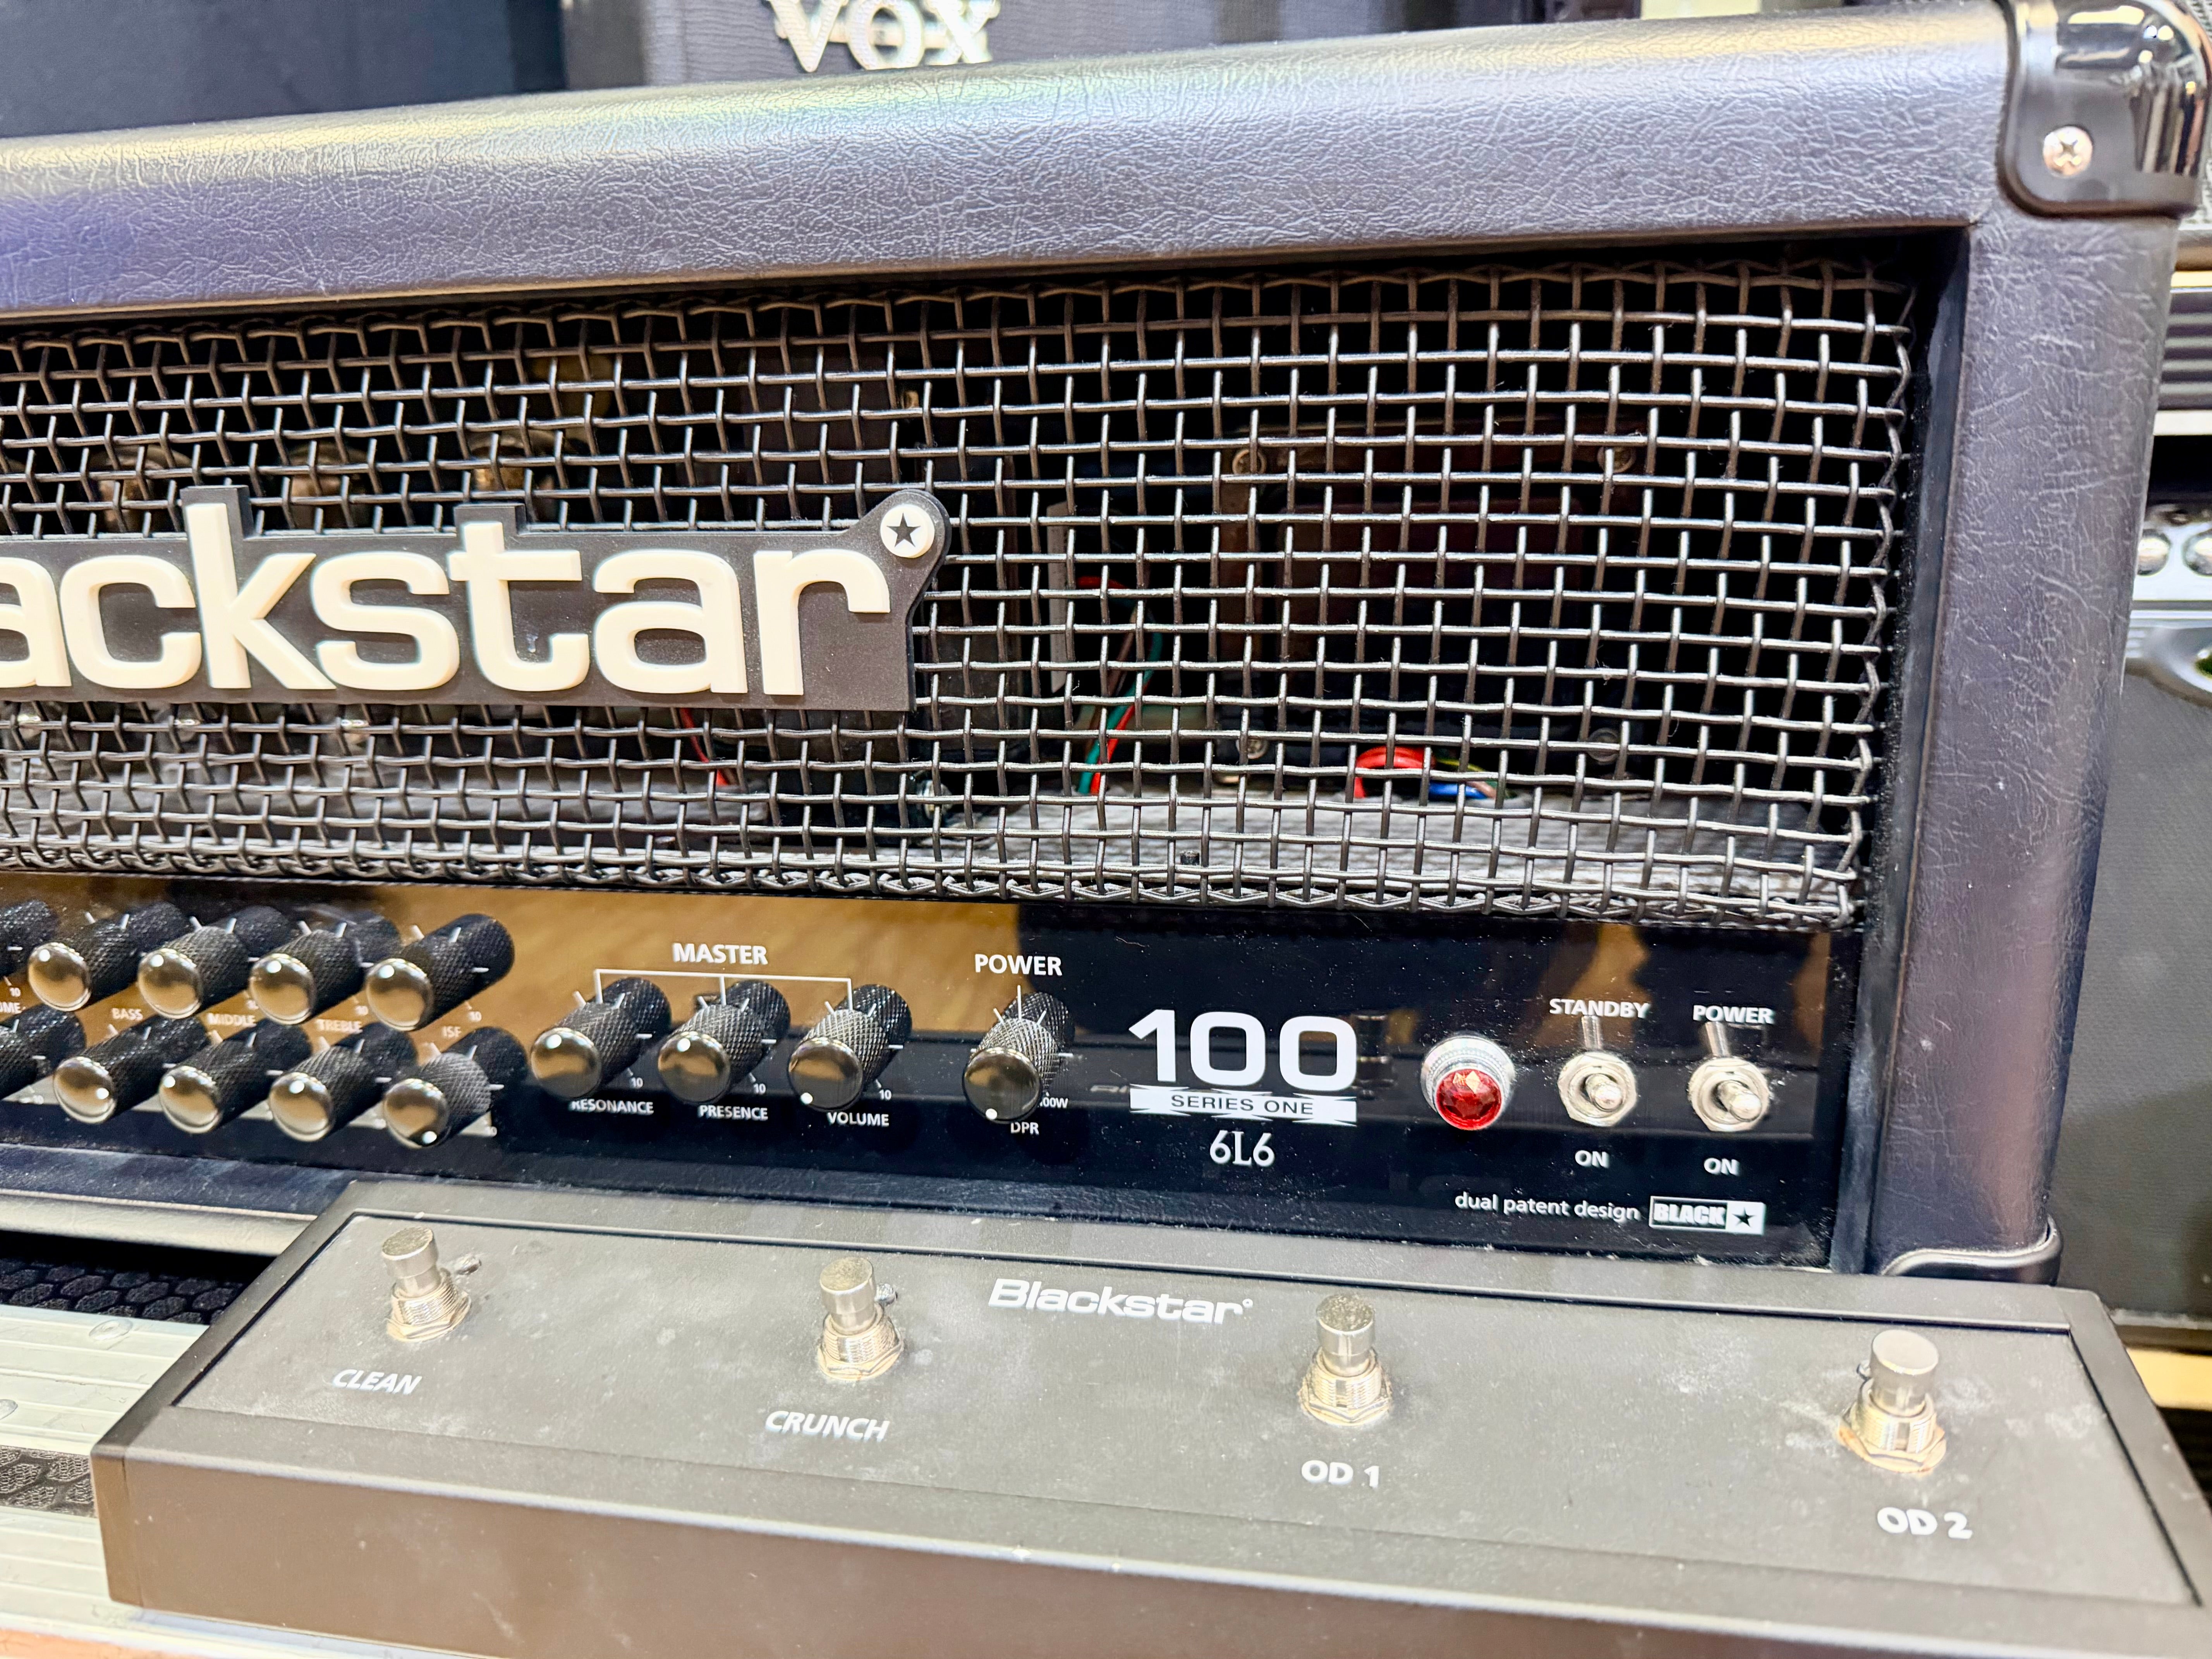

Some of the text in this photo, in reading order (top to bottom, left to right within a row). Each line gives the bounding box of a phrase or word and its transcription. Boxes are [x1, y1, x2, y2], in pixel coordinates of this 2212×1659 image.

[767, 0, 1000, 72] VOX
[673, 942, 768, 965] MASTER
[975, 953, 1062, 977] POWER
[10, 988, 21, 997] 10
[111, 1008, 143, 1020] BASS
[469, 1011, 482, 1022] 10
[1549, 998, 1650, 1019] STANDBY
[1692, 1005, 1775, 1025] POWER
[207, 1013, 256, 1027] MIDDLE
[316, 1019, 363, 1034] TREBLE
[442, 1026, 462, 1038] ISF
[1128, 1009, 1357, 1091] 100
[630, 1077, 643, 1089] 10
[754, 1083, 766, 1094] 10
[878, 1089, 892, 1101] 10
[1171, 1093, 1314, 1115] SERIES ONE
[570, 1099, 654, 1115] RESONANCE
[699, 1104, 768, 1121] PRESENCE
[827, 1111, 890, 1127] VOLUME
[1011, 1121, 1039, 1135] DPR
[1209, 1130, 1275, 1167] 6L6
[1575, 1150, 1609, 1168] ON
[1704, 1158, 1739, 1176] ON
[1455, 1192, 1640, 1224] dual patent design
[1653, 1202, 1726, 1226] BLACK
[988, 1278, 1244, 1325] Blackstar
[332, 1368, 421, 1395] CLEAN
[765, 1410, 890, 1443] CRUNCH
[1300, 1459, 1380, 1488] OD 1
[1877, 1506, 1973, 1540] OD 2
